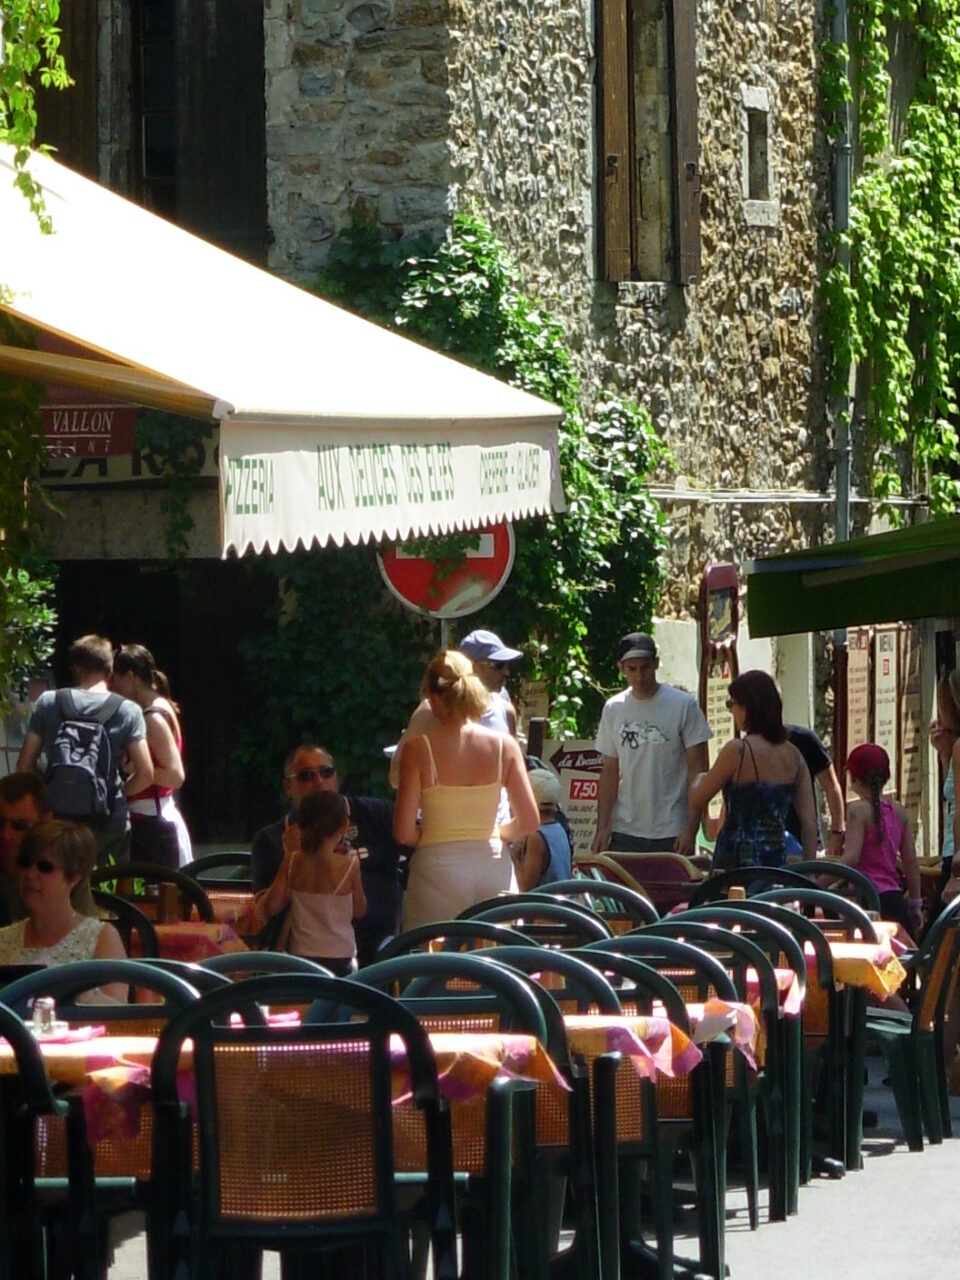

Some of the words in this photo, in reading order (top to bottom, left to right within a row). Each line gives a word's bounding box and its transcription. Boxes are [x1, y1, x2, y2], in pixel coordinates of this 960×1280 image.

[52, 411, 114, 432] VALLON
[225, 457, 273, 515] PIZZERIA
[316, 444, 346, 511] AUX
[348, 442, 398, 506] DELICES
[401, 442, 424, 504] DES
[573, 781, 598, 798] 7,50
